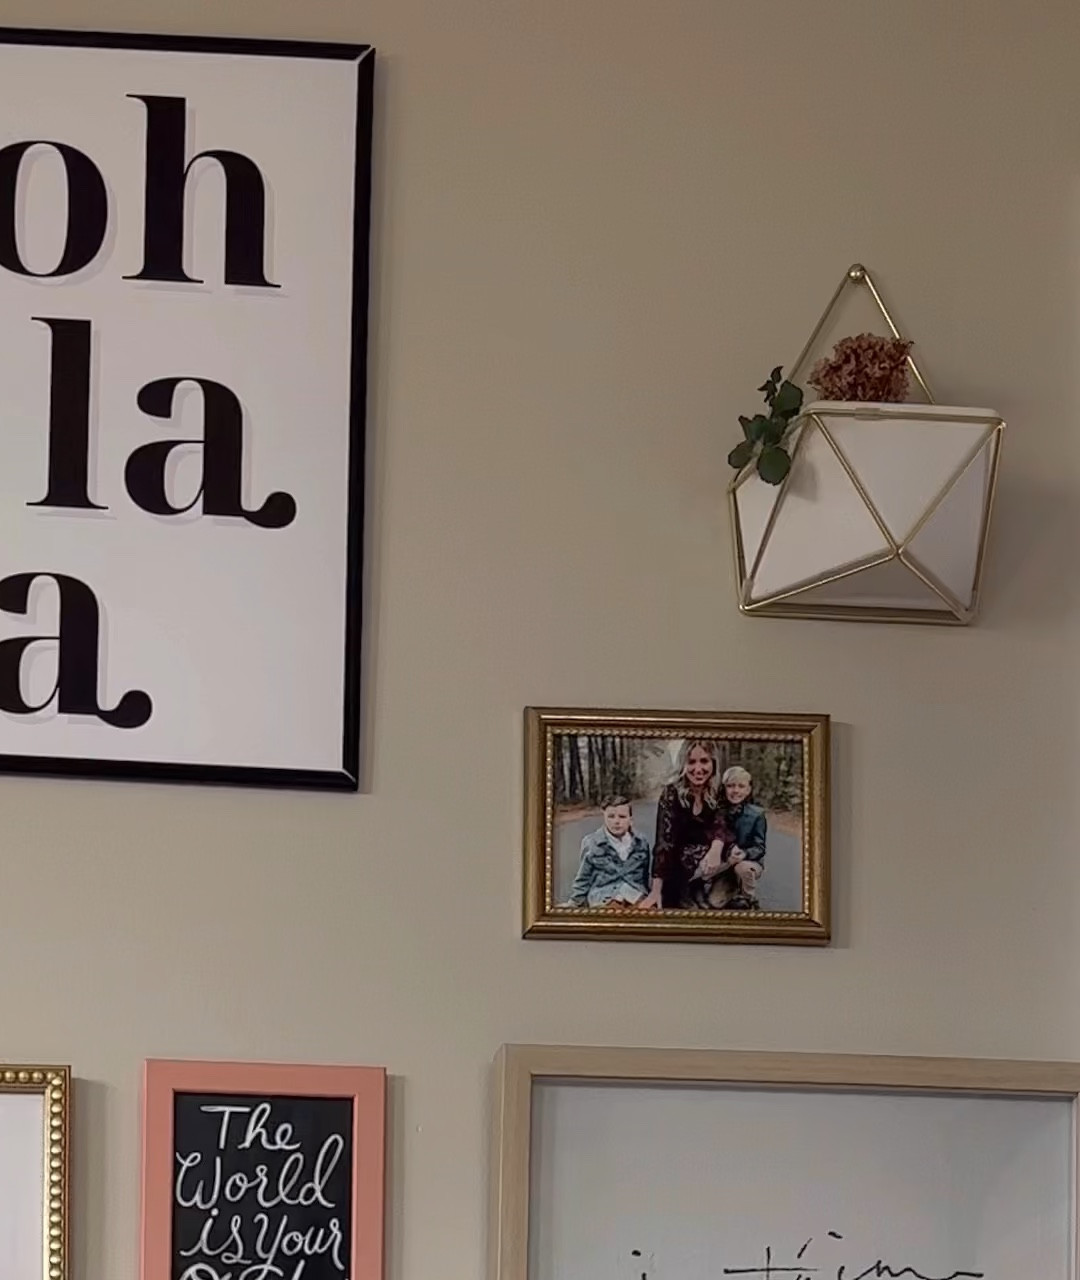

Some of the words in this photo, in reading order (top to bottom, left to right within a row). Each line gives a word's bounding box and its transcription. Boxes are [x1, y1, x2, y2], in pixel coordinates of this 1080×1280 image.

[26, 316, 297, 529] la
[199, 1102, 301, 1150] The
[175, 1133, 345, 1210] World
[179, 1207, 252, 1265] is
